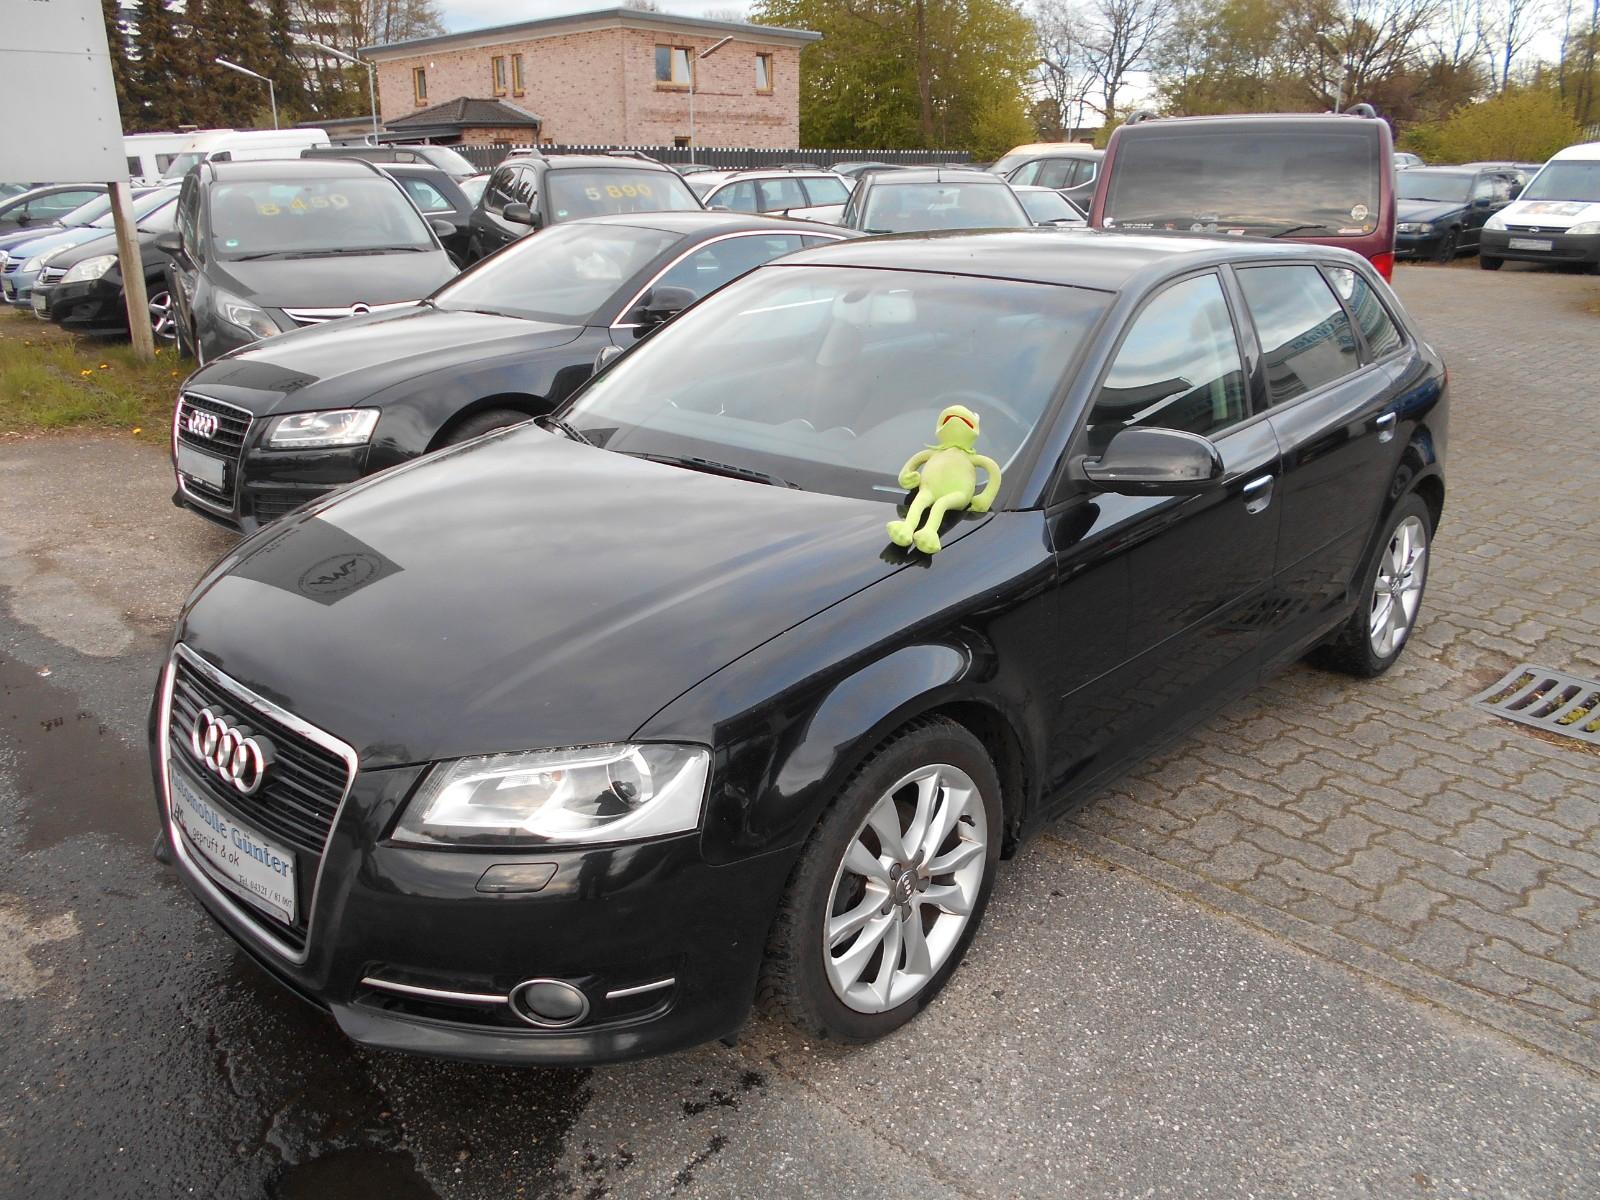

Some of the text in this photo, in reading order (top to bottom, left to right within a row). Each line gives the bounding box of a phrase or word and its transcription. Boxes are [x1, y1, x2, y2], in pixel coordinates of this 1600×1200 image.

[585, 186, 601, 201] 5
[229, 850, 240, 866] ok
[230, 826, 289, 878] Günter
